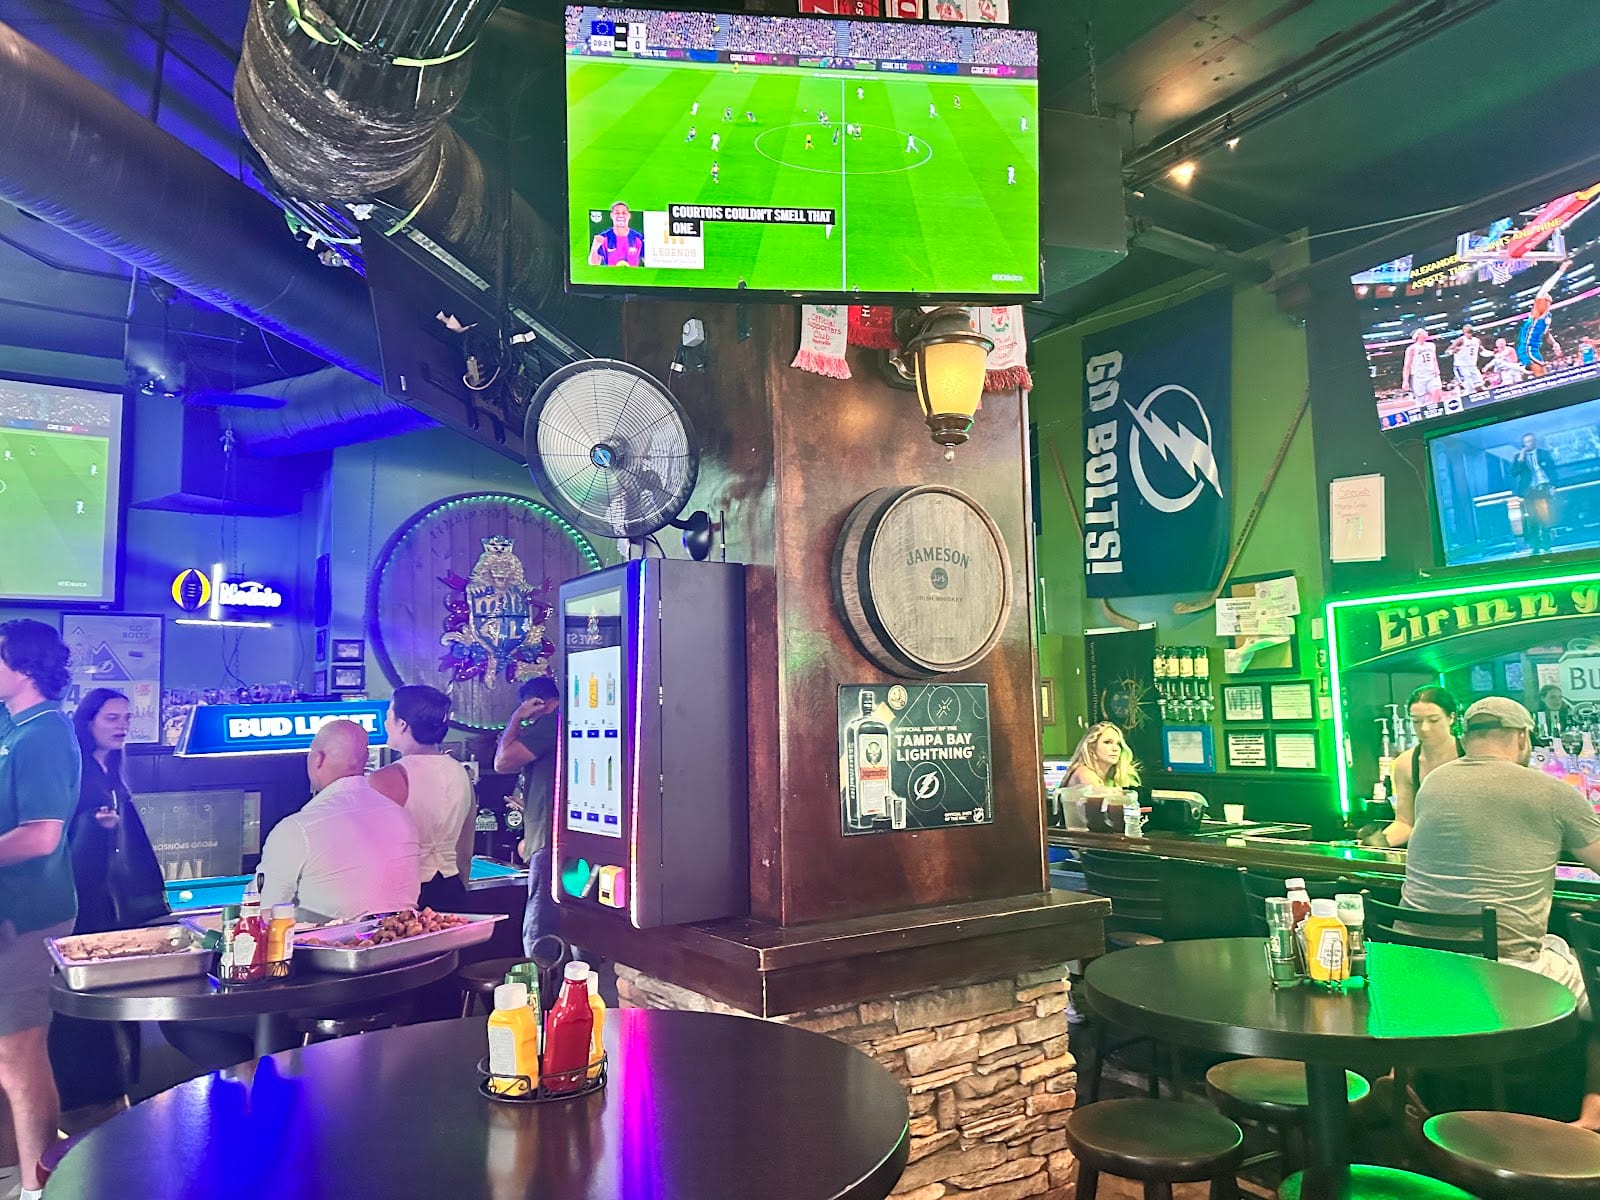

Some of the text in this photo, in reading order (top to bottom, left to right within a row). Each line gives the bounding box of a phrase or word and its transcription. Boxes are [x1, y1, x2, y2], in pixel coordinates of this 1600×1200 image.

[634, 40, 641, 50] 0
[672, 205, 832, 223] COURTOIS COULDN'T SMELL THAT
[672, 223, 697, 235] ONE.
[1536, 217, 1561, 233] NINE
[652, 247, 697, 257] LEGENDS
[807, 318, 842, 335] Supporters
[813, 330, 831, 341] Club
[1085, 350, 1123, 575] GO BOLTS!
[906, 547, 970, 568] JAMESON
[1376, 590, 1558, 652] Eirinn
[122, 631, 149, 639] BOLTS
[228, 713, 378, 738] BUD LIT
[894, 732, 973, 747] TAMPA BAY
[896, 746, 973, 762] LIGHTNING
[191, 840, 218, 848] PROUD
